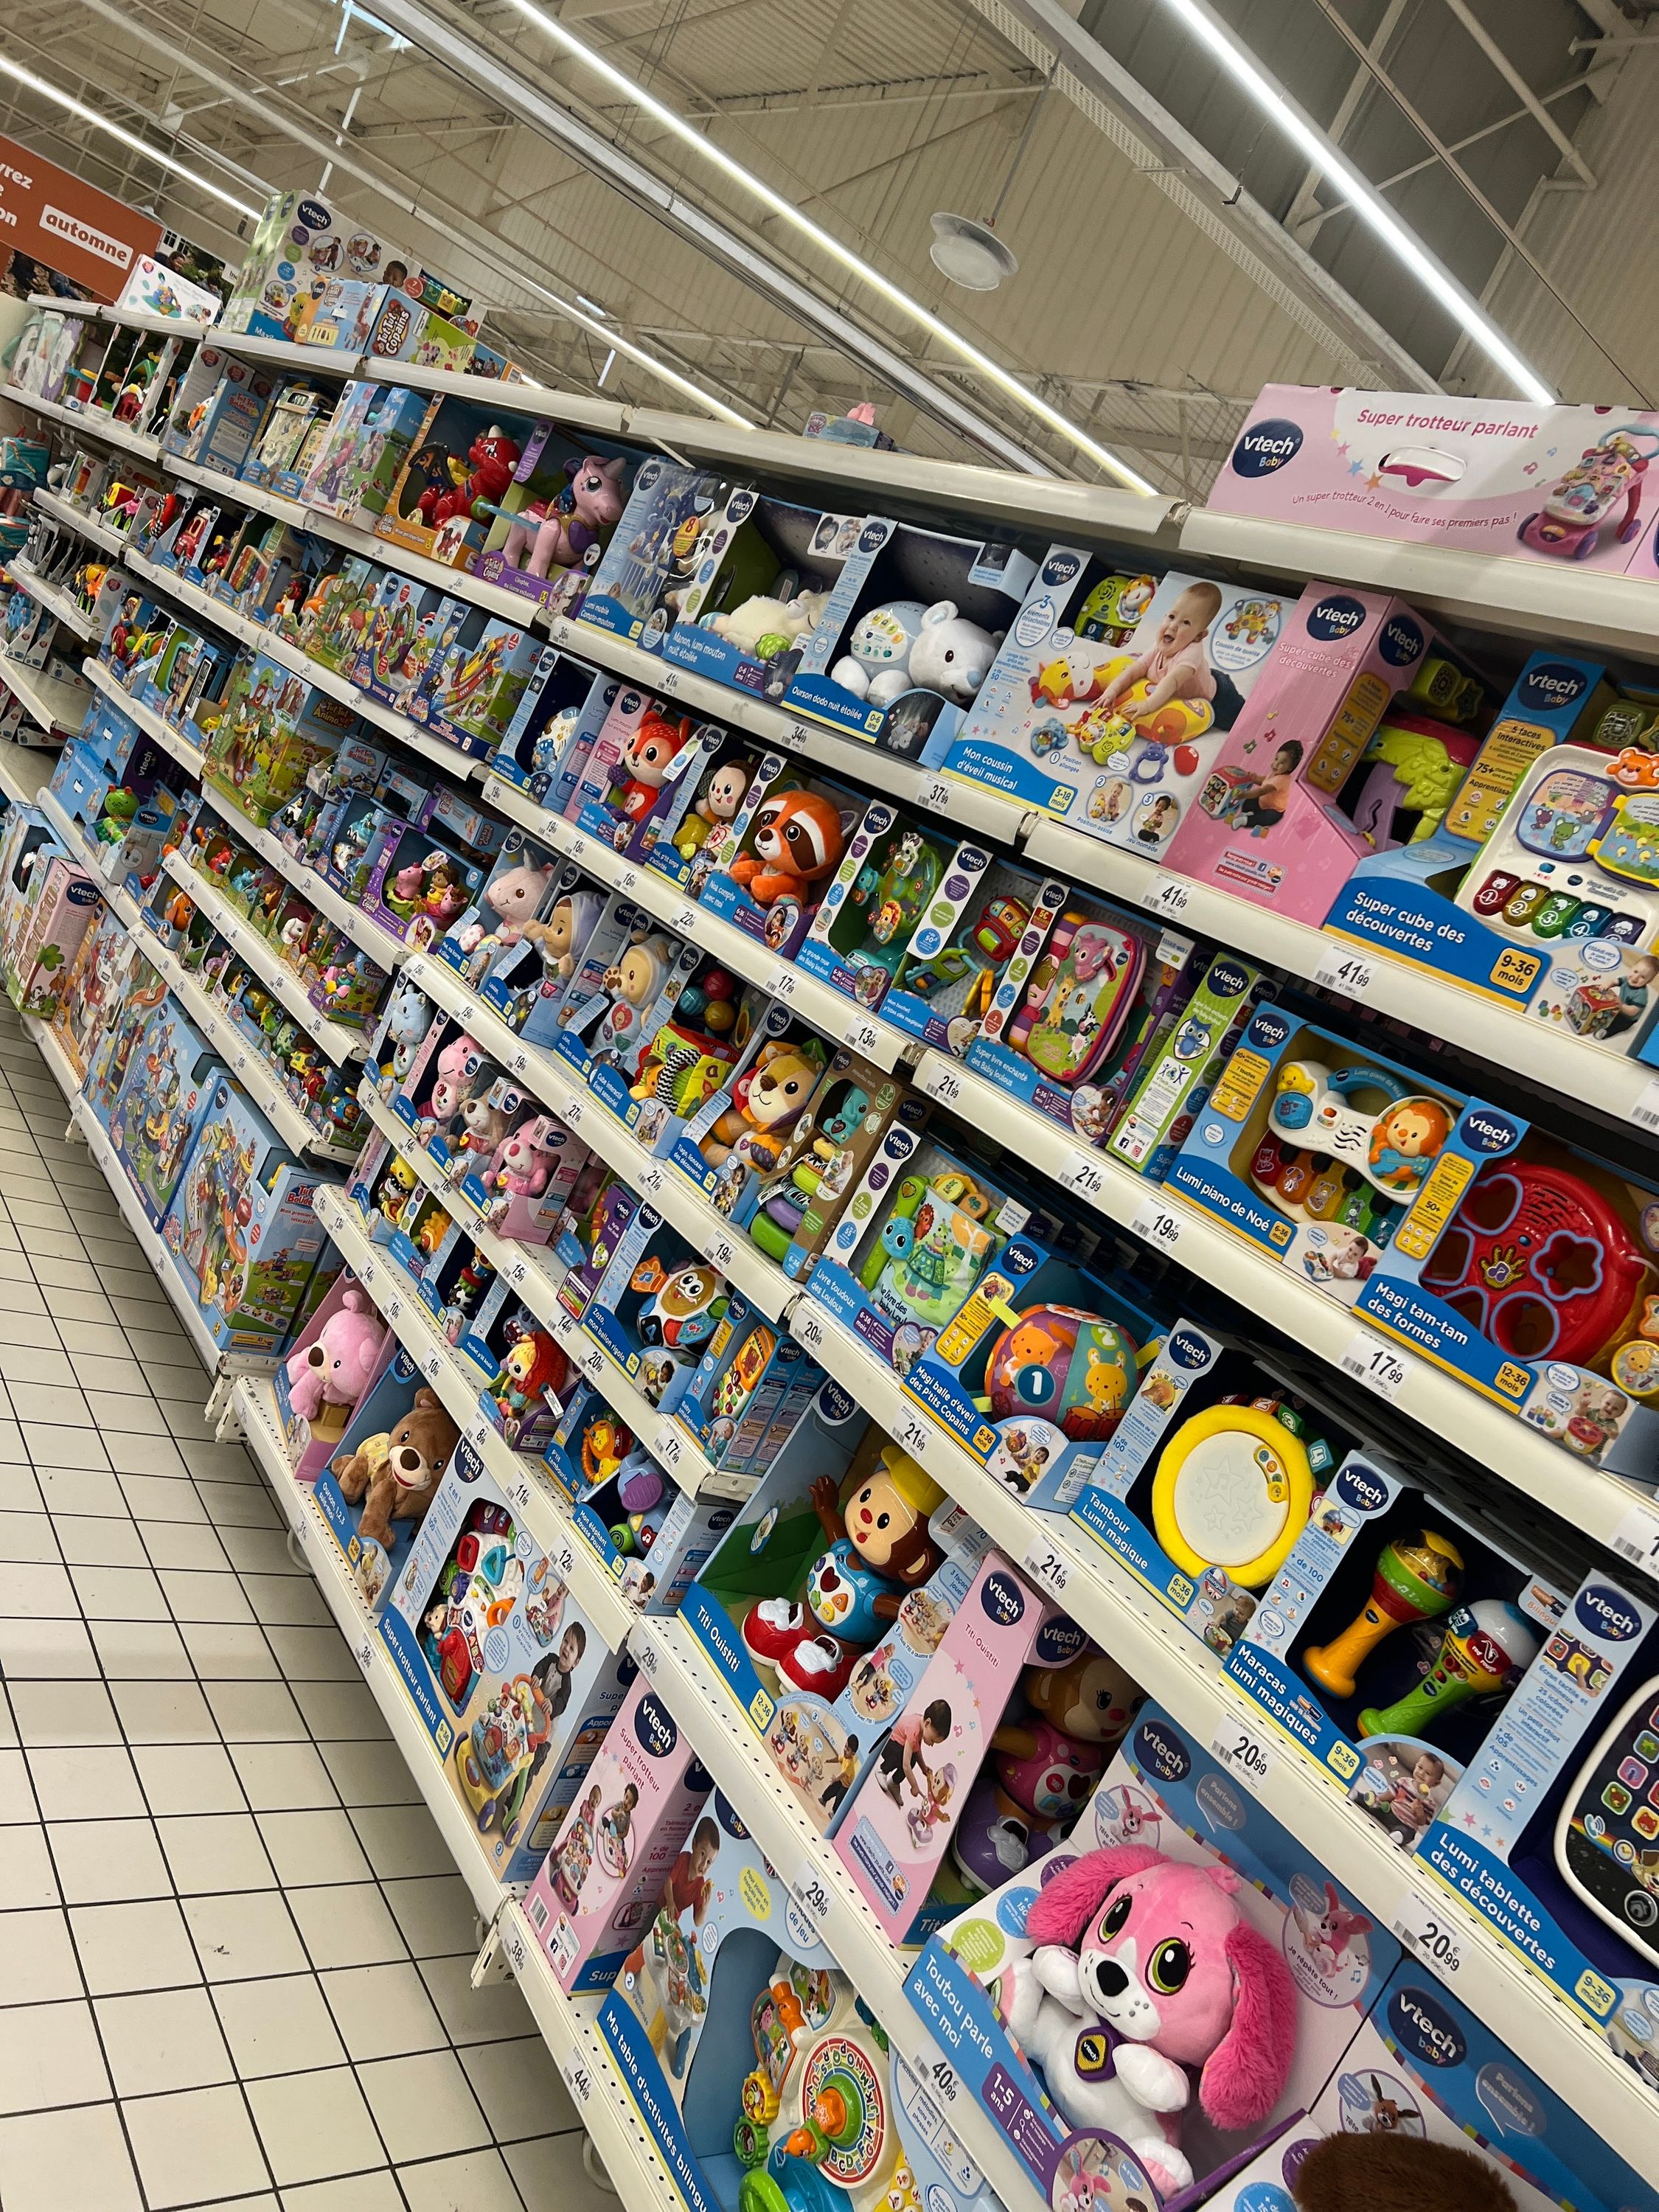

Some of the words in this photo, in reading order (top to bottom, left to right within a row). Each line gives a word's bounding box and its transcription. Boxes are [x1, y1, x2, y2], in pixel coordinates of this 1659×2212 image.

[302, 204, 328, 226] vtech
[46, 214, 127, 262] automne
[386, 310, 410, 355] Copains
[1357, 409, 1403, 426] Super
[1406, 414, 1470, 433] trotteur
[1472, 421, 1538, 438] parlant
[1245, 436, 1295, 454] vtech
[1259, 456, 1284, 467] Baby
[1293, 495, 1304, 504] Un
[1307, 493, 1330, 503] super
[1332, 491, 1366, 503] trotteur
[1367, 496, 1376, 506] 2
[1374, 500, 1384, 511] en
[1388, 507, 1410, 519] pour
[1411, 512, 1430, 526] faire
[1432, 516, 1445, 527] ses
[1447, 518, 1489, 533] premiers
[1491, 515, 1509, 529] pas
[864, 530, 884, 541] vtech
[1048, 561, 1077, 574] vtech
[1317, 607, 1359, 625] vtech
[1329, 625, 1350, 636] Baby
[668, 645, 680, 656] nuit
[679, 648, 698, 663] étoilée
[673, 635, 690, 649] Manon,
[692, 641, 702, 653] lumi
[703, 647, 726, 661] mouton
[1279, 642, 1307, 657] Super
[1307, 649, 1331, 664] cube
[1334, 656, 1351, 669] des
[1528, 673, 1579, 695] vtech
[792, 686, 812, 700] Ourson
[813, 693, 829, 706] dodo
[827, 699, 840, 712] nuit
[840, 703, 862, 720] étoilée
[1544, 694, 1570, 706] Baby
[1512, 726, 1517, 734] 5
[1519, 728, 1542, 740] faces
[957, 759, 984, 779] d'éveil
[984, 770, 1018, 790] musical
[963, 746, 985, 762] Mon
[981, 753, 1014, 773] coussin
[1051, 799, 1065, 808] mois
[1055, 788, 1071, 801] 3-18
[1136, 840, 1158, 853] nomade
[70, 885, 99, 898] vtech
[1346, 908, 1433, 953] découvertes
[1354, 891, 1396, 917] Super
[1400, 908, 1435, 932] cube
[1437, 923, 1466, 945] des
[1498, 967, 1525, 986] mois
[1502, 955, 1536, 977] 9-36
[1255, 1018, 1286, 1039] vtech
[971, 1056, 982, 1068] des
[980, 1060, 995, 1076] Baby
[992, 1068, 1014, 1087] loulous
[975, 1044, 993, 1060] Super
[990, 1055, 1004, 1068] livre
[1002, 1061, 1029, 1082] enchanté
[888, 1133, 910, 1153] vtech
[1469, 1116, 1512, 1144] vtech
[1481, 1137, 1502, 1150] Baby
[1176, 1166, 1201, 1190] Lumi
[1200, 1185, 1231, 1208] piano
[1231, 1200, 1246, 1217] de
[1245, 1208, 1270, 1233] Noé
[1007, 1245, 1034, 1269] vtech
[811, 1281, 822, 1295] des
[821, 1290, 843, 1315] Loulous
[817, 1268, 830, 1284] Livre
[830, 1281, 856, 1309] toudoux
[1368, 1298, 1391, 1319] des
[1394, 1312, 1441, 1349] formes
[1375, 1281, 1409, 1309] Magi
[1409, 1301, 1469, 1346] tam-tam
[1175, 1335, 1207, 1363] vtech
[1499, 1377, 1519, 1393] mois
[1500, 1366, 1527, 1386] 12-36
[909, 1376, 924, 1393] des
[939, 1402, 970, 1436] Copains
[916, 1366, 935, 1386] Magi
[932, 1379, 952, 1402] balle
[950, 1394, 976, 1425] d'éveil
[978, 1428, 994, 1444] 6-36
[1344, 1469, 1384, 1503] vtech
[1090, 1492, 1130, 1534] Tambour
[1082, 1504, 1107, 1531] Lumi
[1105, 1525, 1148, 1570] magique
[988, 1577, 1020, 1618] vtech
[1205, 1575, 1225, 1594] Bilingue
[1585, 1590, 1635, 1634] vtech
[697, 1604, 712, 1626] Titi
[709, 1624, 741, 1673] Ouistiti
[383, 1617, 400, 1646] Super
[397, 1646, 418, 1690] trotteur
[414, 1686, 437, 1725] parlant
[1237, 1644, 1287, 1695] Maracas
[1229, 1658, 1258, 1690] lumi
[1257, 1685, 1318, 1745] magiques
[642, 1698, 672, 1750] vtech
[1142, 1725, 1186, 1774] vtech
[1332, 1756, 1347, 1773] mois
[1334, 1745, 1357, 1767] 9-36
[1489, 1743, 1538, 1789] Apprentissages
[1200, 1787, 1232, 1822] ensemble
[1210, 1780, 1239, 1812] Parlons
[1439, 1832, 1479, 1874] Lumi
[1479, 1868, 1541, 1933] tablette
[1430, 1850, 1456, 1879] des
[1460, 1877, 1557, 1972] découvertes
[1287, 1945, 1296, 1956] Je
[1296, 1953, 1318, 1978] répète
[1318, 1975, 1334, 1996] tout
[913, 1978, 940, 2017] avec
[938, 2016, 961, 2049] moi
[924, 1955, 965, 2017] Toutou
[961, 2011, 994, 2059] parle
[605, 2008, 620, 2037] Ma
[617, 2034, 639, 2076] table
[635, 2076, 678, 2159] d'activités
[991, 2073, 1016, 2106] 1-5
[989, 2092, 1004, 2112] ans
